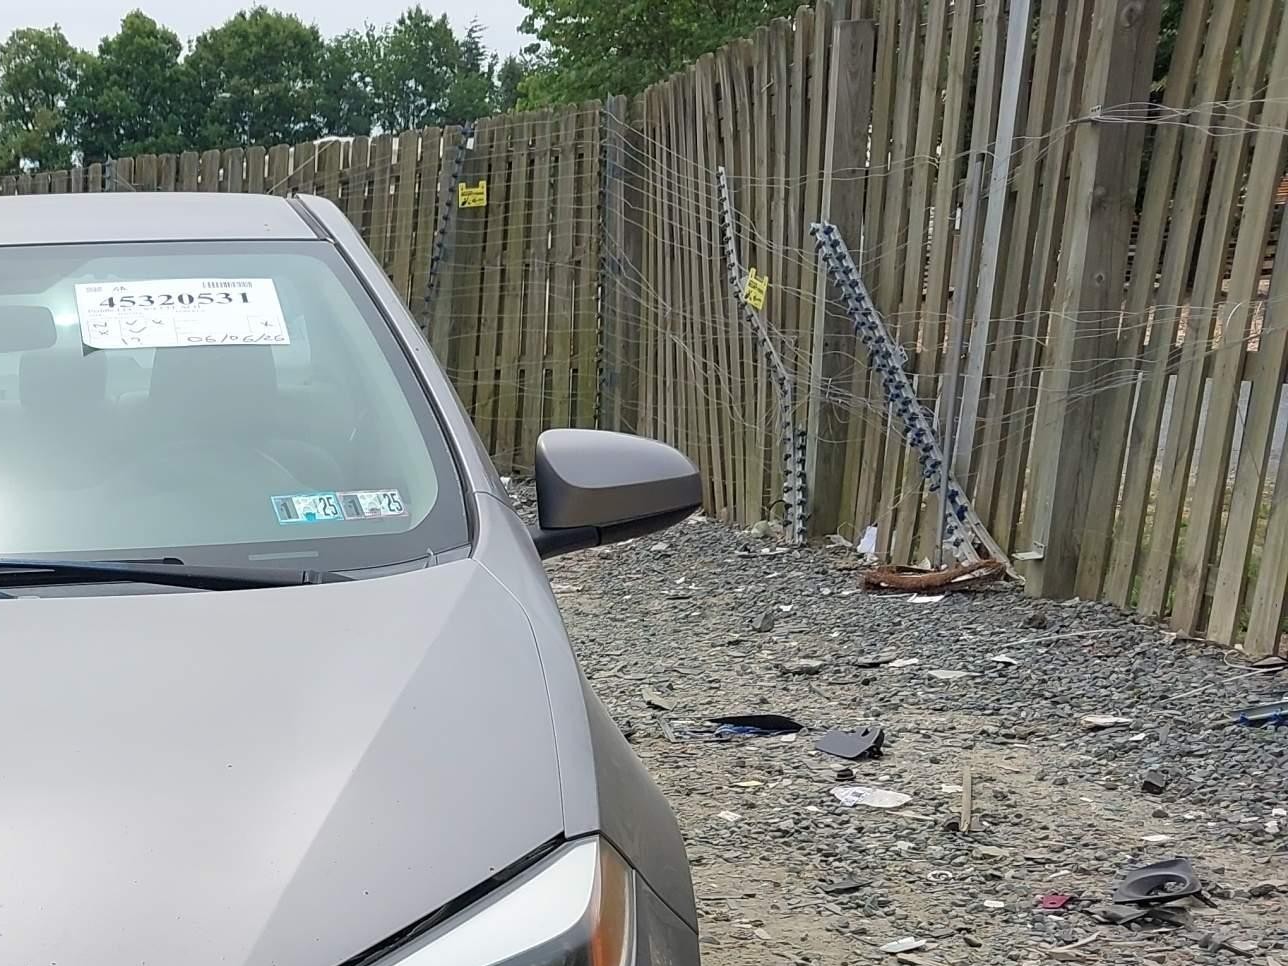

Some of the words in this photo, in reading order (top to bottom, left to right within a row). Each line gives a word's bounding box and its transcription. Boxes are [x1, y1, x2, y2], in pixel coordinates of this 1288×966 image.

[99, 292, 249, 308] 45320531
[186, 333, 286, 344] 06/06/26
[319, 497, 338, 516] 25
[383, 493, 403, 512] 25
